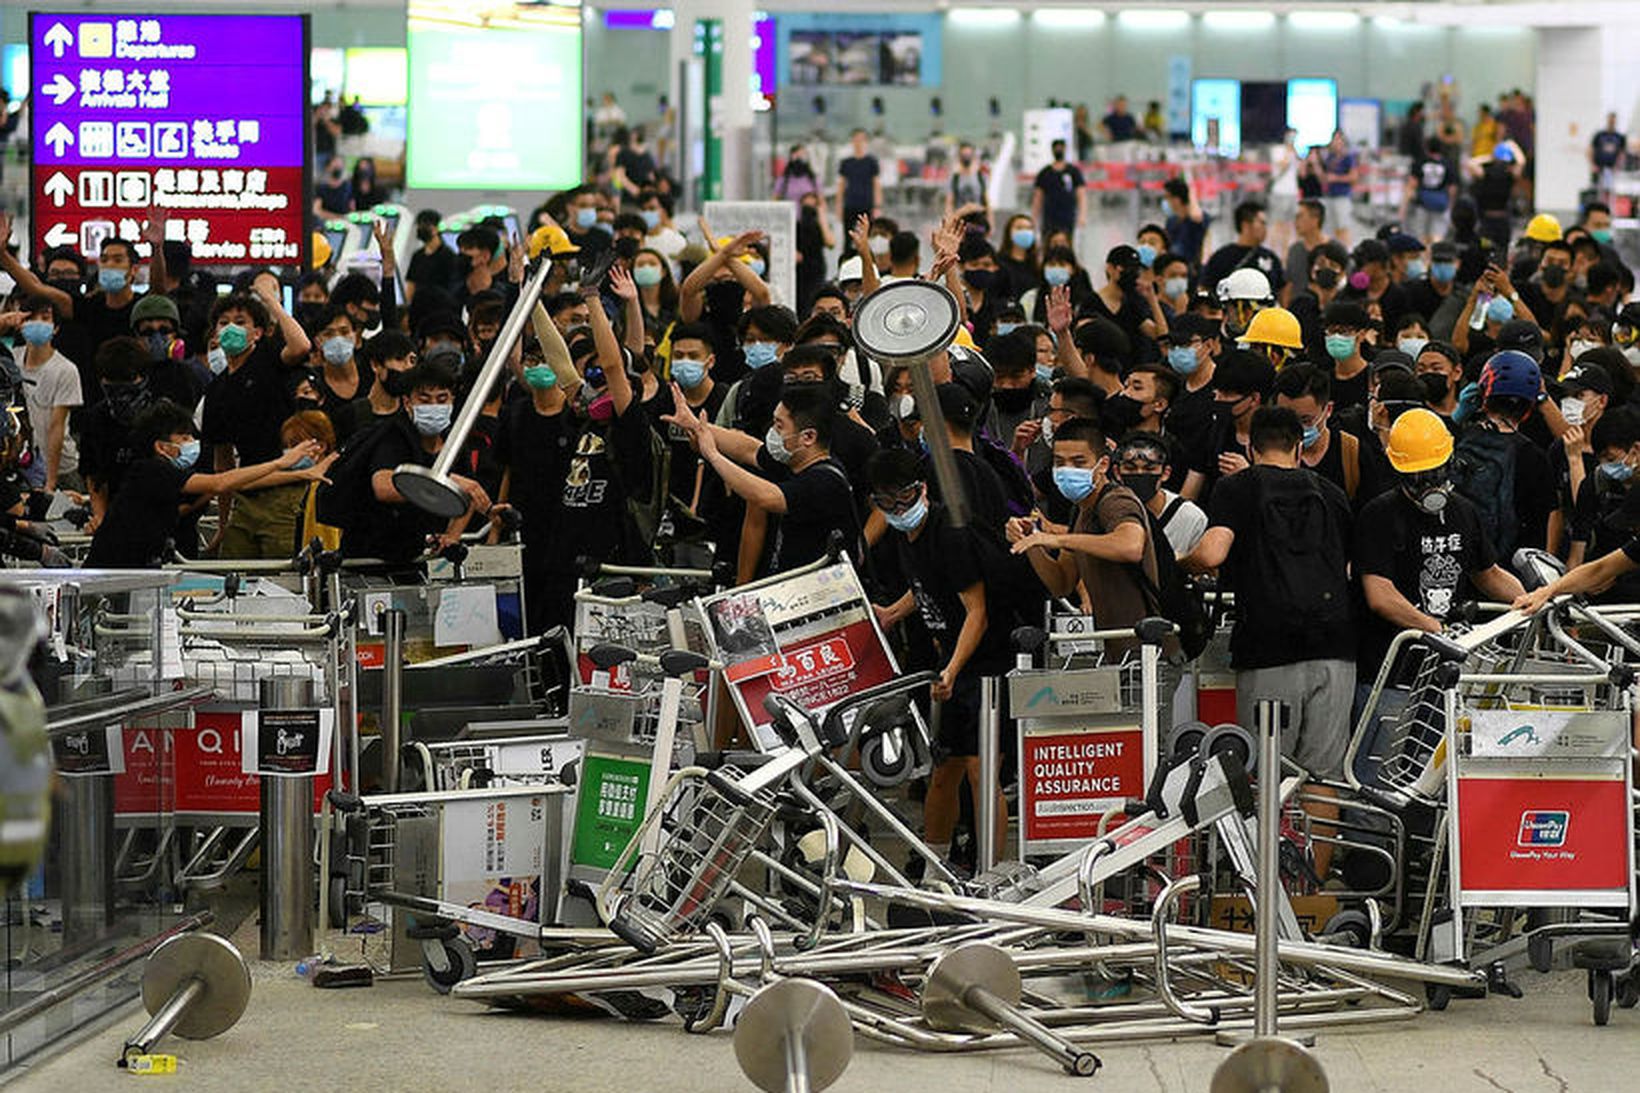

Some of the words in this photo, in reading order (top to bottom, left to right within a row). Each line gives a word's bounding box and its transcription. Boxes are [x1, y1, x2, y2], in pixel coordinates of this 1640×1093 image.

[116, 43, 196, 60] Departures
[1034, 743, 1124, 760] INTELLIGENT
[1034, 762, 1095, 778] QUALITY
[1035, 777, 1121, 794] ASSURANCE
